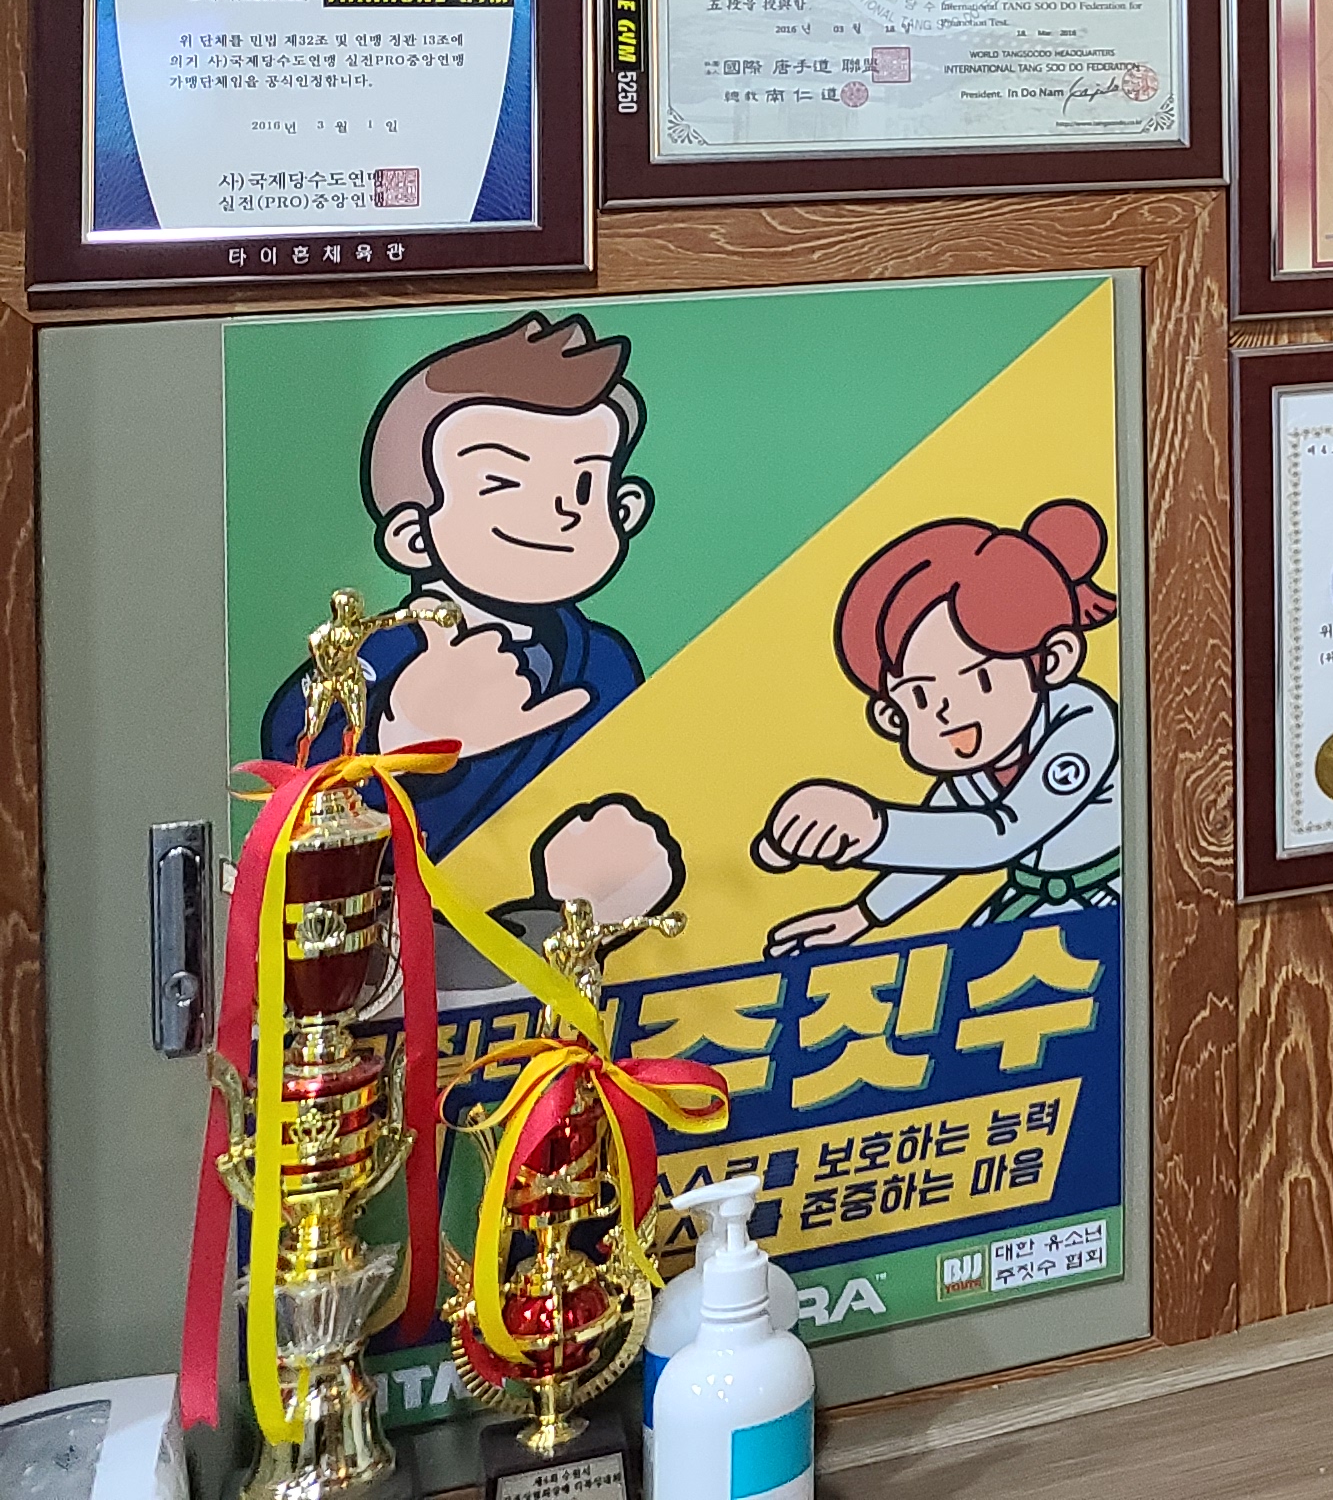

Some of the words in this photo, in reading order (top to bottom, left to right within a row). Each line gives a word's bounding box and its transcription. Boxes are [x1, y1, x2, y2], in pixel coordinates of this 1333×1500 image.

[617, 16, 637, 64] GYM
[617, 71, 637, 114] 5250
[228, 243, 406, 268] 타이혼체육관
[631, 926, 1105, 1110] 주짓수
[815, 1121, 970, 1182] 보호하는
[987, 1099, 1060, 1145] 능력
[801, 1173, 955, 1229] 존중하는
[971, 1149, 1043, 1193] 마음
[994, 1238, 1035, 1260] 대한
[1044, 1225, 1103, 1252] 유소년
[996, 1258, 1057, 1285] 주짓수
[1066, 1249, 1104, 1269] 협회
